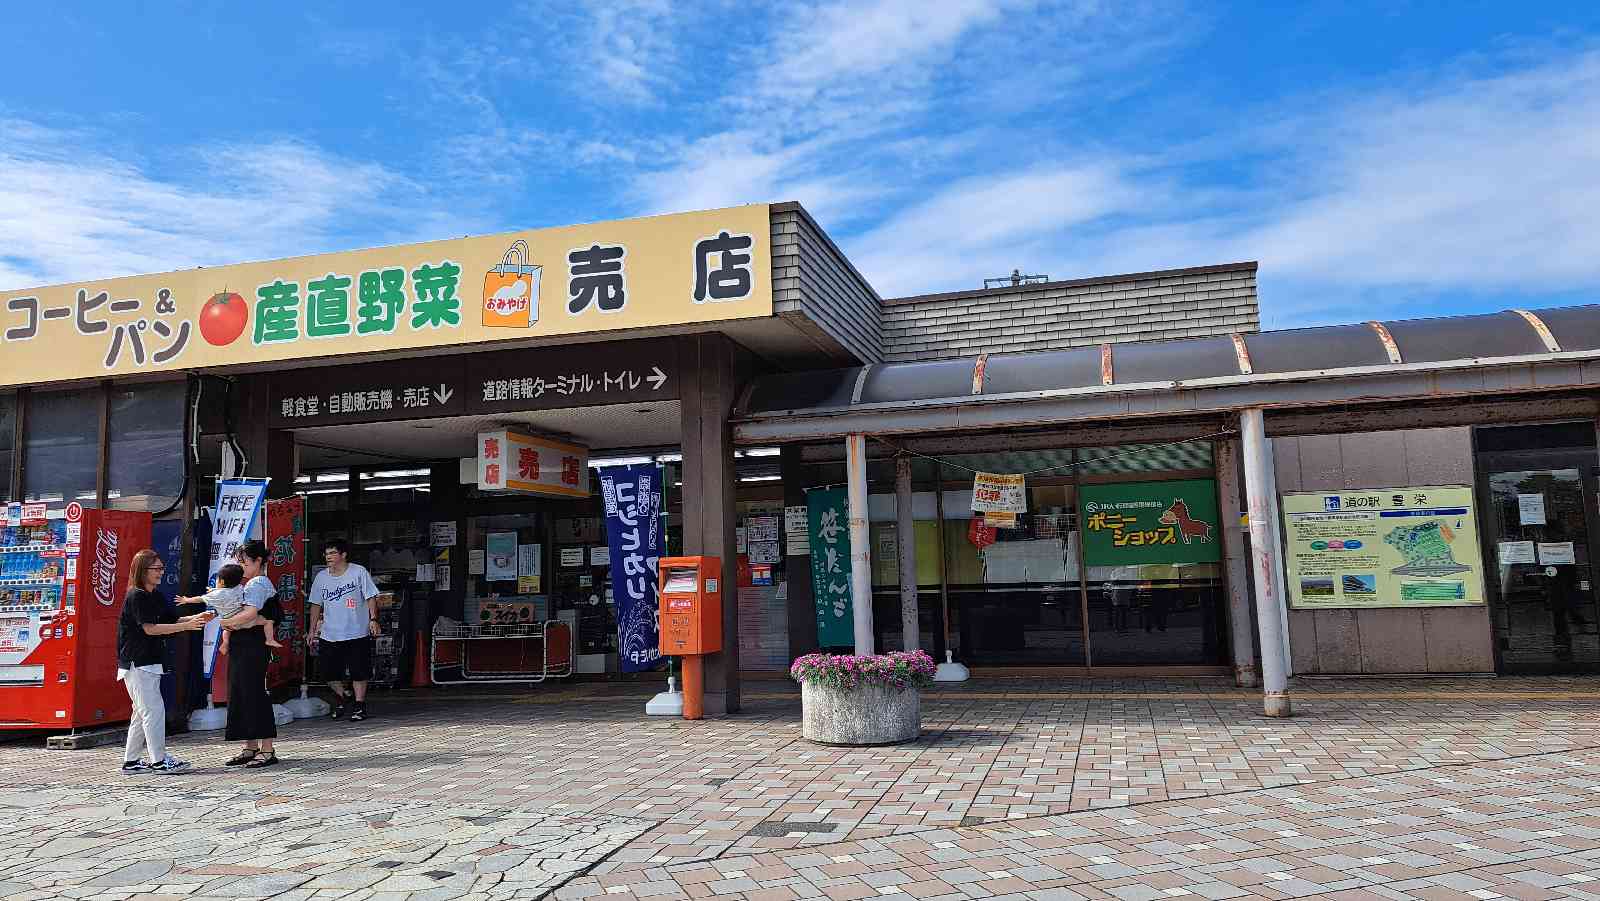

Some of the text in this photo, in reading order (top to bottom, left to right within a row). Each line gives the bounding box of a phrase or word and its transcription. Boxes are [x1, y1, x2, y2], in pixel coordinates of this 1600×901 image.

[568, 231, 753, 314] 売店
[5, 289, 175, 340] コーヒー &
[253, 261, 461, 344] 産直野菜
[486, 298, 528, 312] おみやげ
[105, 320, 190, 367] パン
[484, 438, 500, 484] 売店
[519, 447, 580, 484] 売店
[221, 495, 255, 512] FREE
[1345, 495, 1380, 508] 道の駅
[1087, 512, 1137, 531] ポニー
[1113, 527, 1177, 546] ショップ
[321, 581, 357, 601] Dodgers
